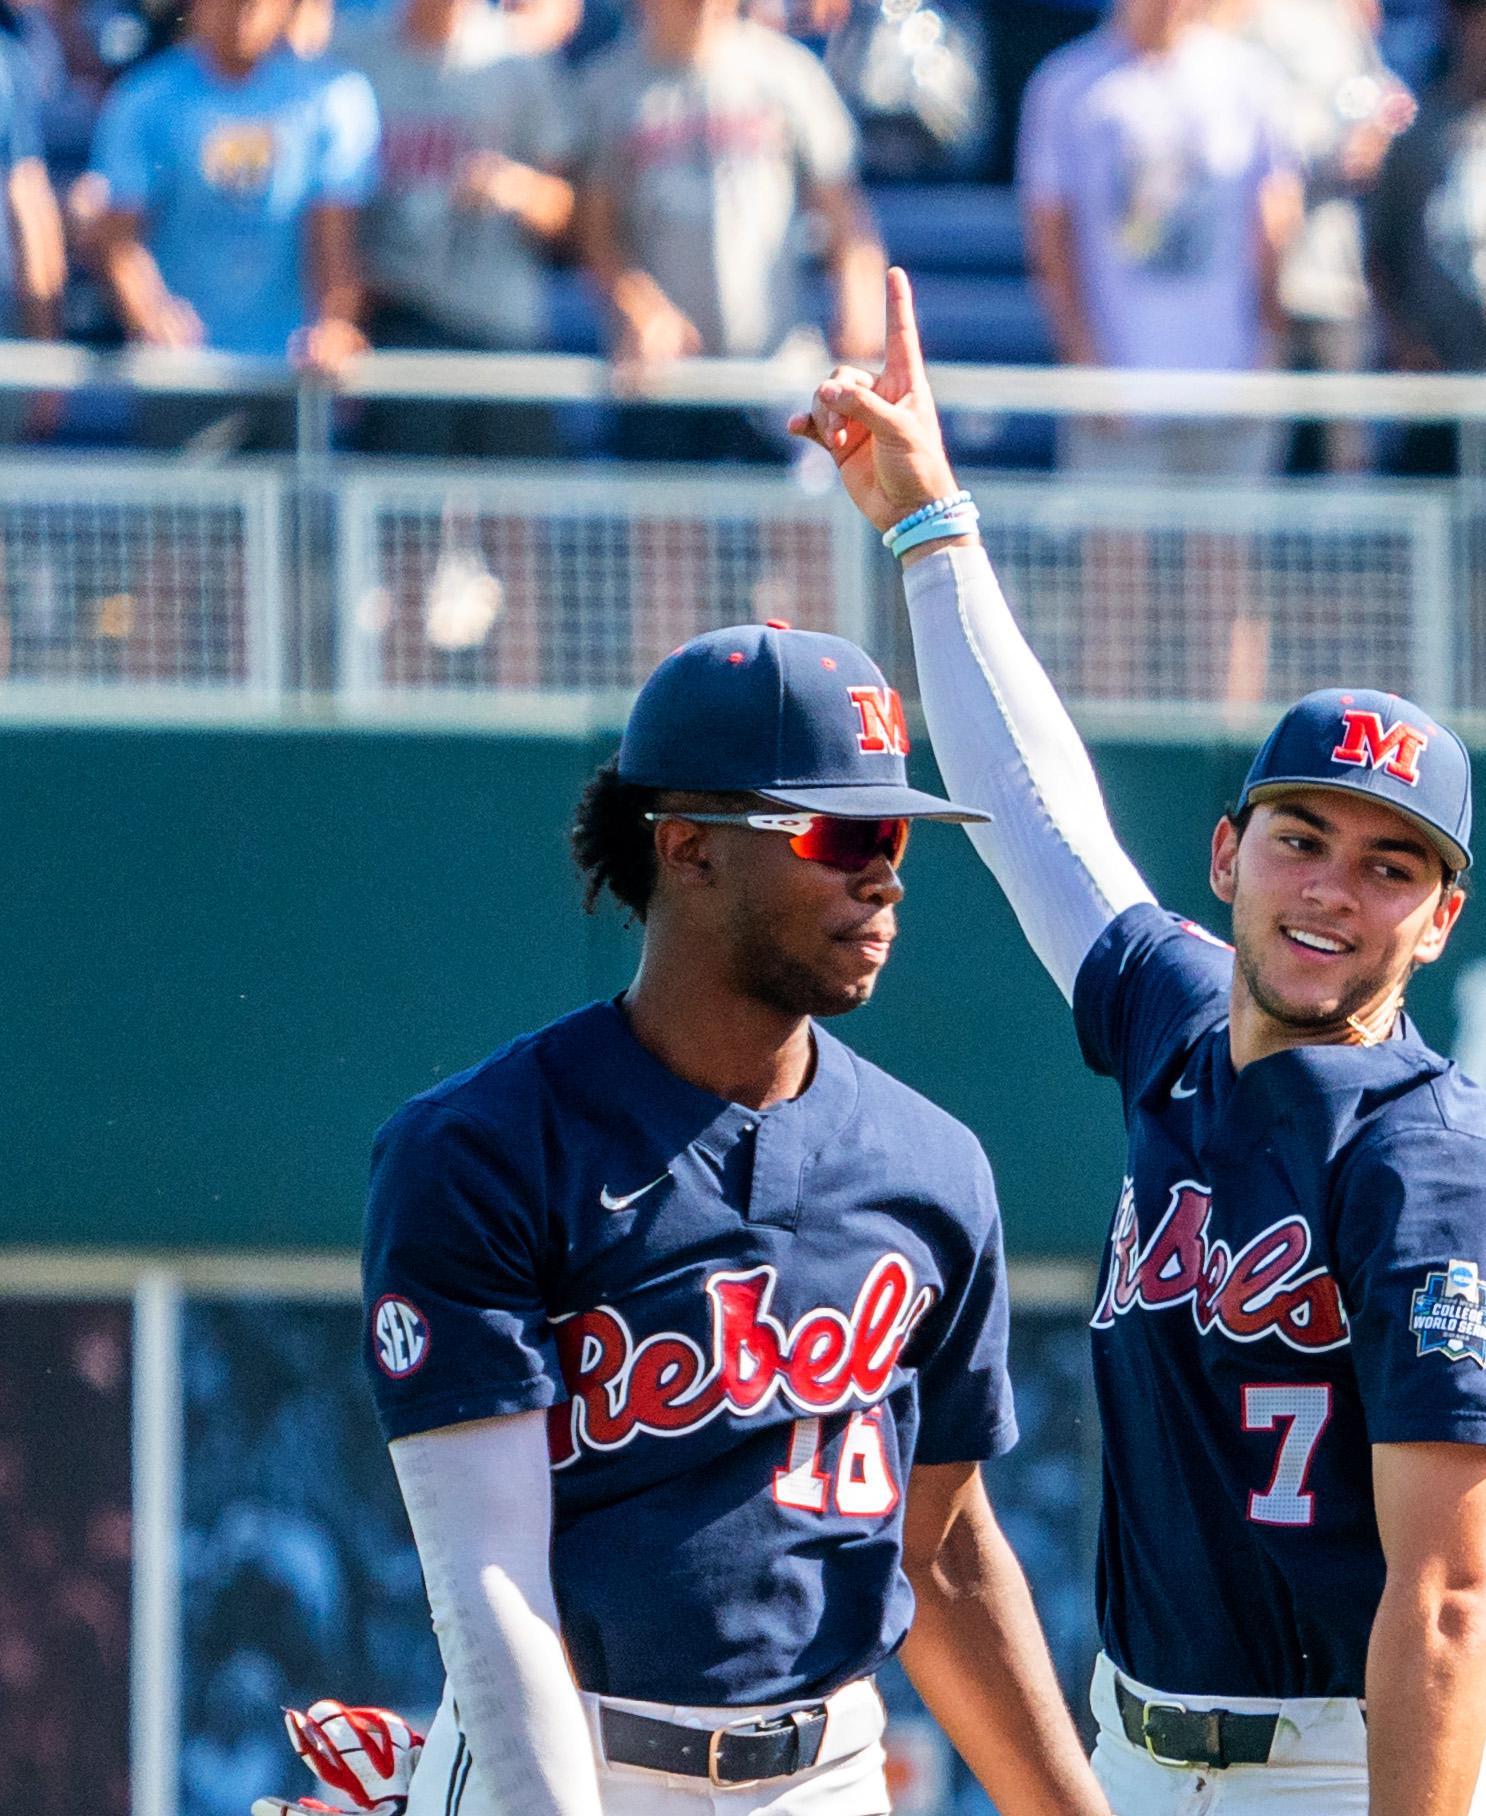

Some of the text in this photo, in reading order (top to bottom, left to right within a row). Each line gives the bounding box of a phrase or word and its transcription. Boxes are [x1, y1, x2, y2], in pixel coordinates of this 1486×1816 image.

[847, 686, 910, 757] M
[1330, 709, 1428, 787] M
[377, 1301, 424, 1372] SEC
[1413, 1315, 1458, 1331] WORLD
[1431, 1303, 1484, 1324] COLLEGE
[1240, 1382, 1332, 1527] 7
